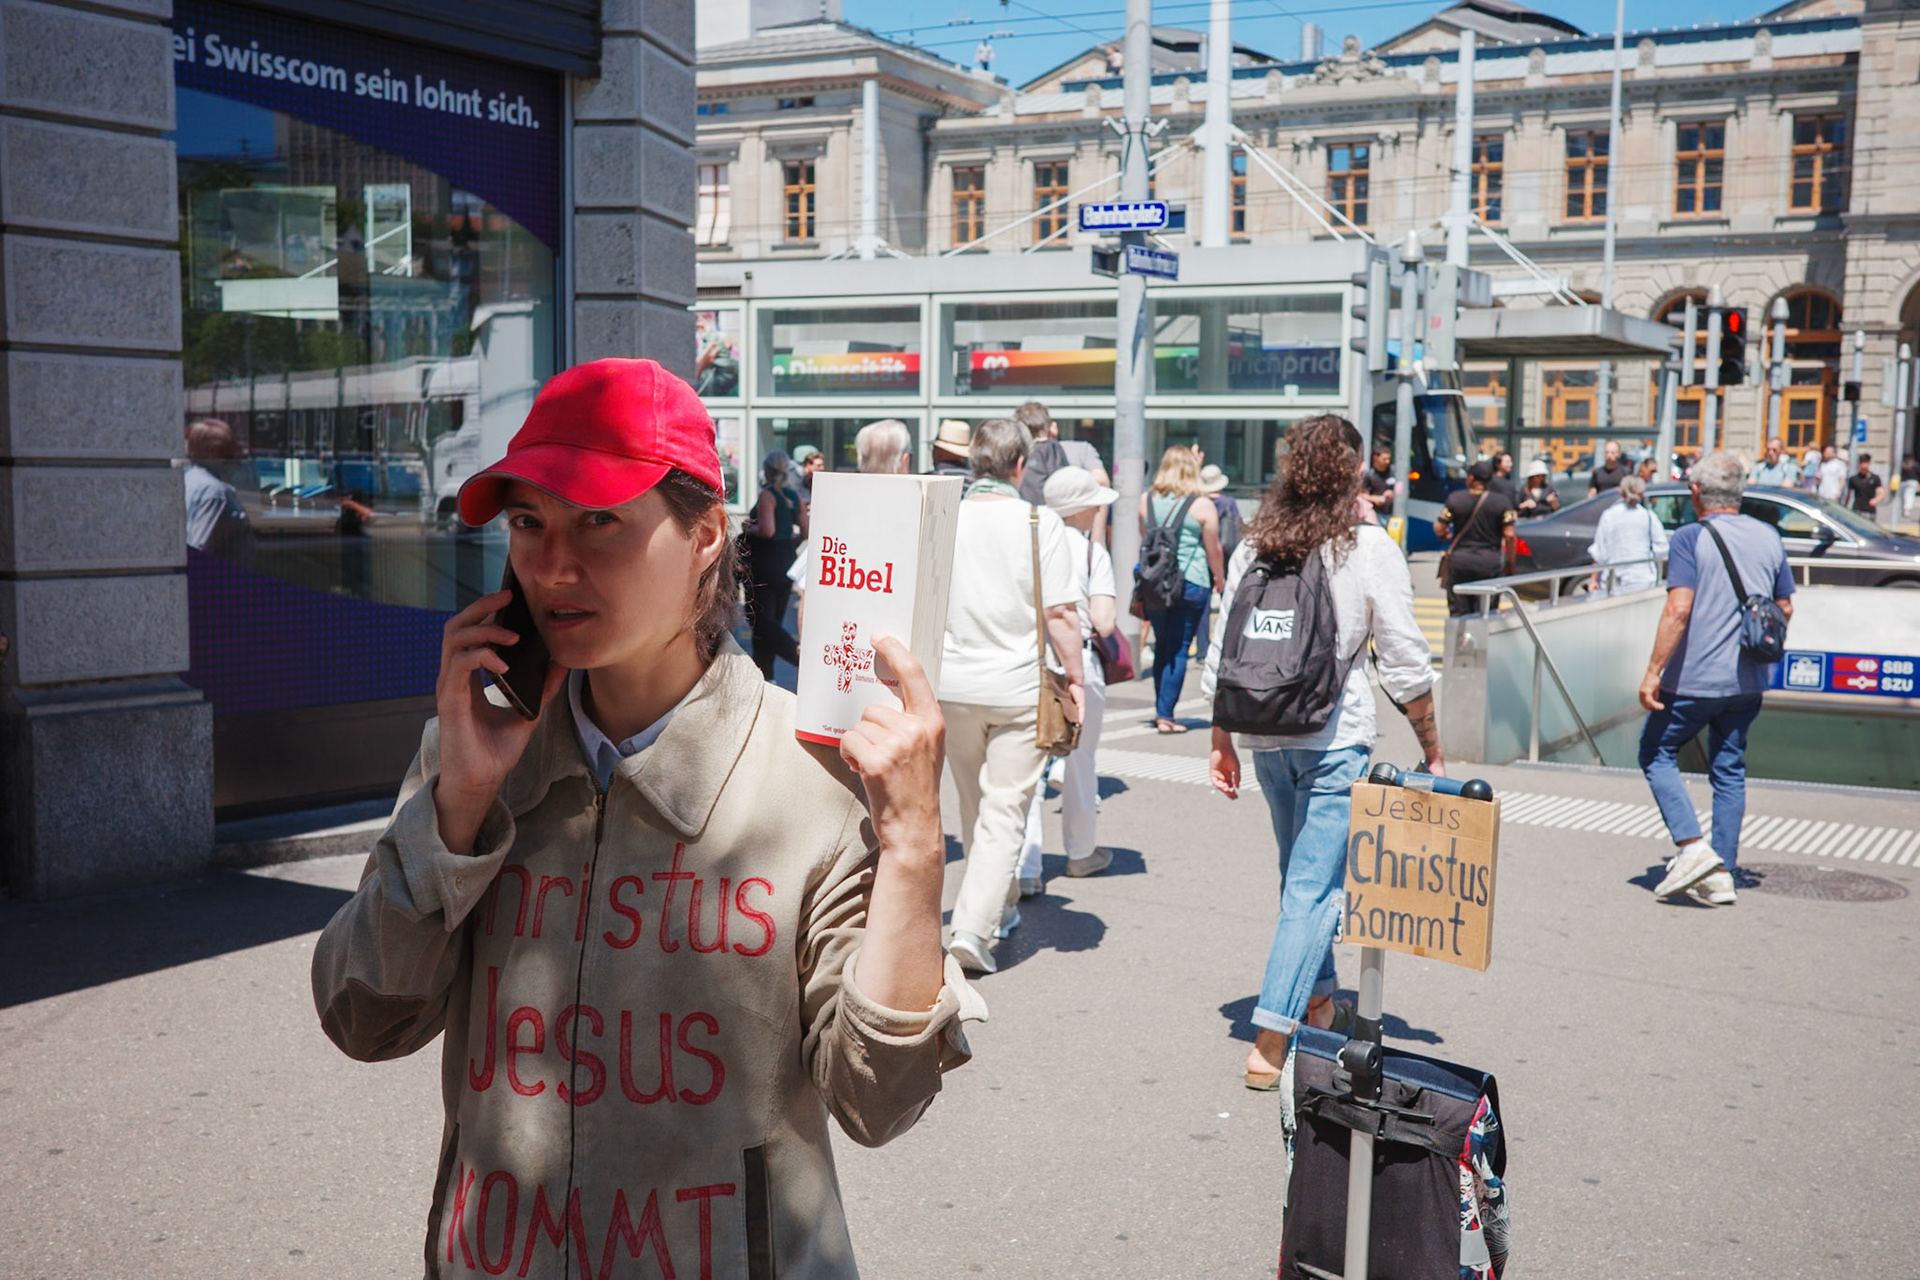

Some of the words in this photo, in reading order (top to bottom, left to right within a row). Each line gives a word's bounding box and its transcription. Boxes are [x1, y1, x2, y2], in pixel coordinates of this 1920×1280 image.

[204, 33, 347, 93] Swisscom
[354, 68, 408, 104] sein
[415, 75, 482, 118] lohnt
[488, 92, 540, 129] sich.
[821, 536, 847, 555] Die
[819, 555, 893, 594] Bibel
[1253, 614, 1294, 633] VANS
[1881, 677, 1914, 692] SZU
[1882, 660, 1914, 675] SBB
[1365, 788, 1461, 831] Jesus
[1349, 824, 1489, 907] Christus
[476, 842, 776, 957] hristus
[469, 966, 726, 1107] Jesus
[447, 1163, 737, 1280] KOMMT
